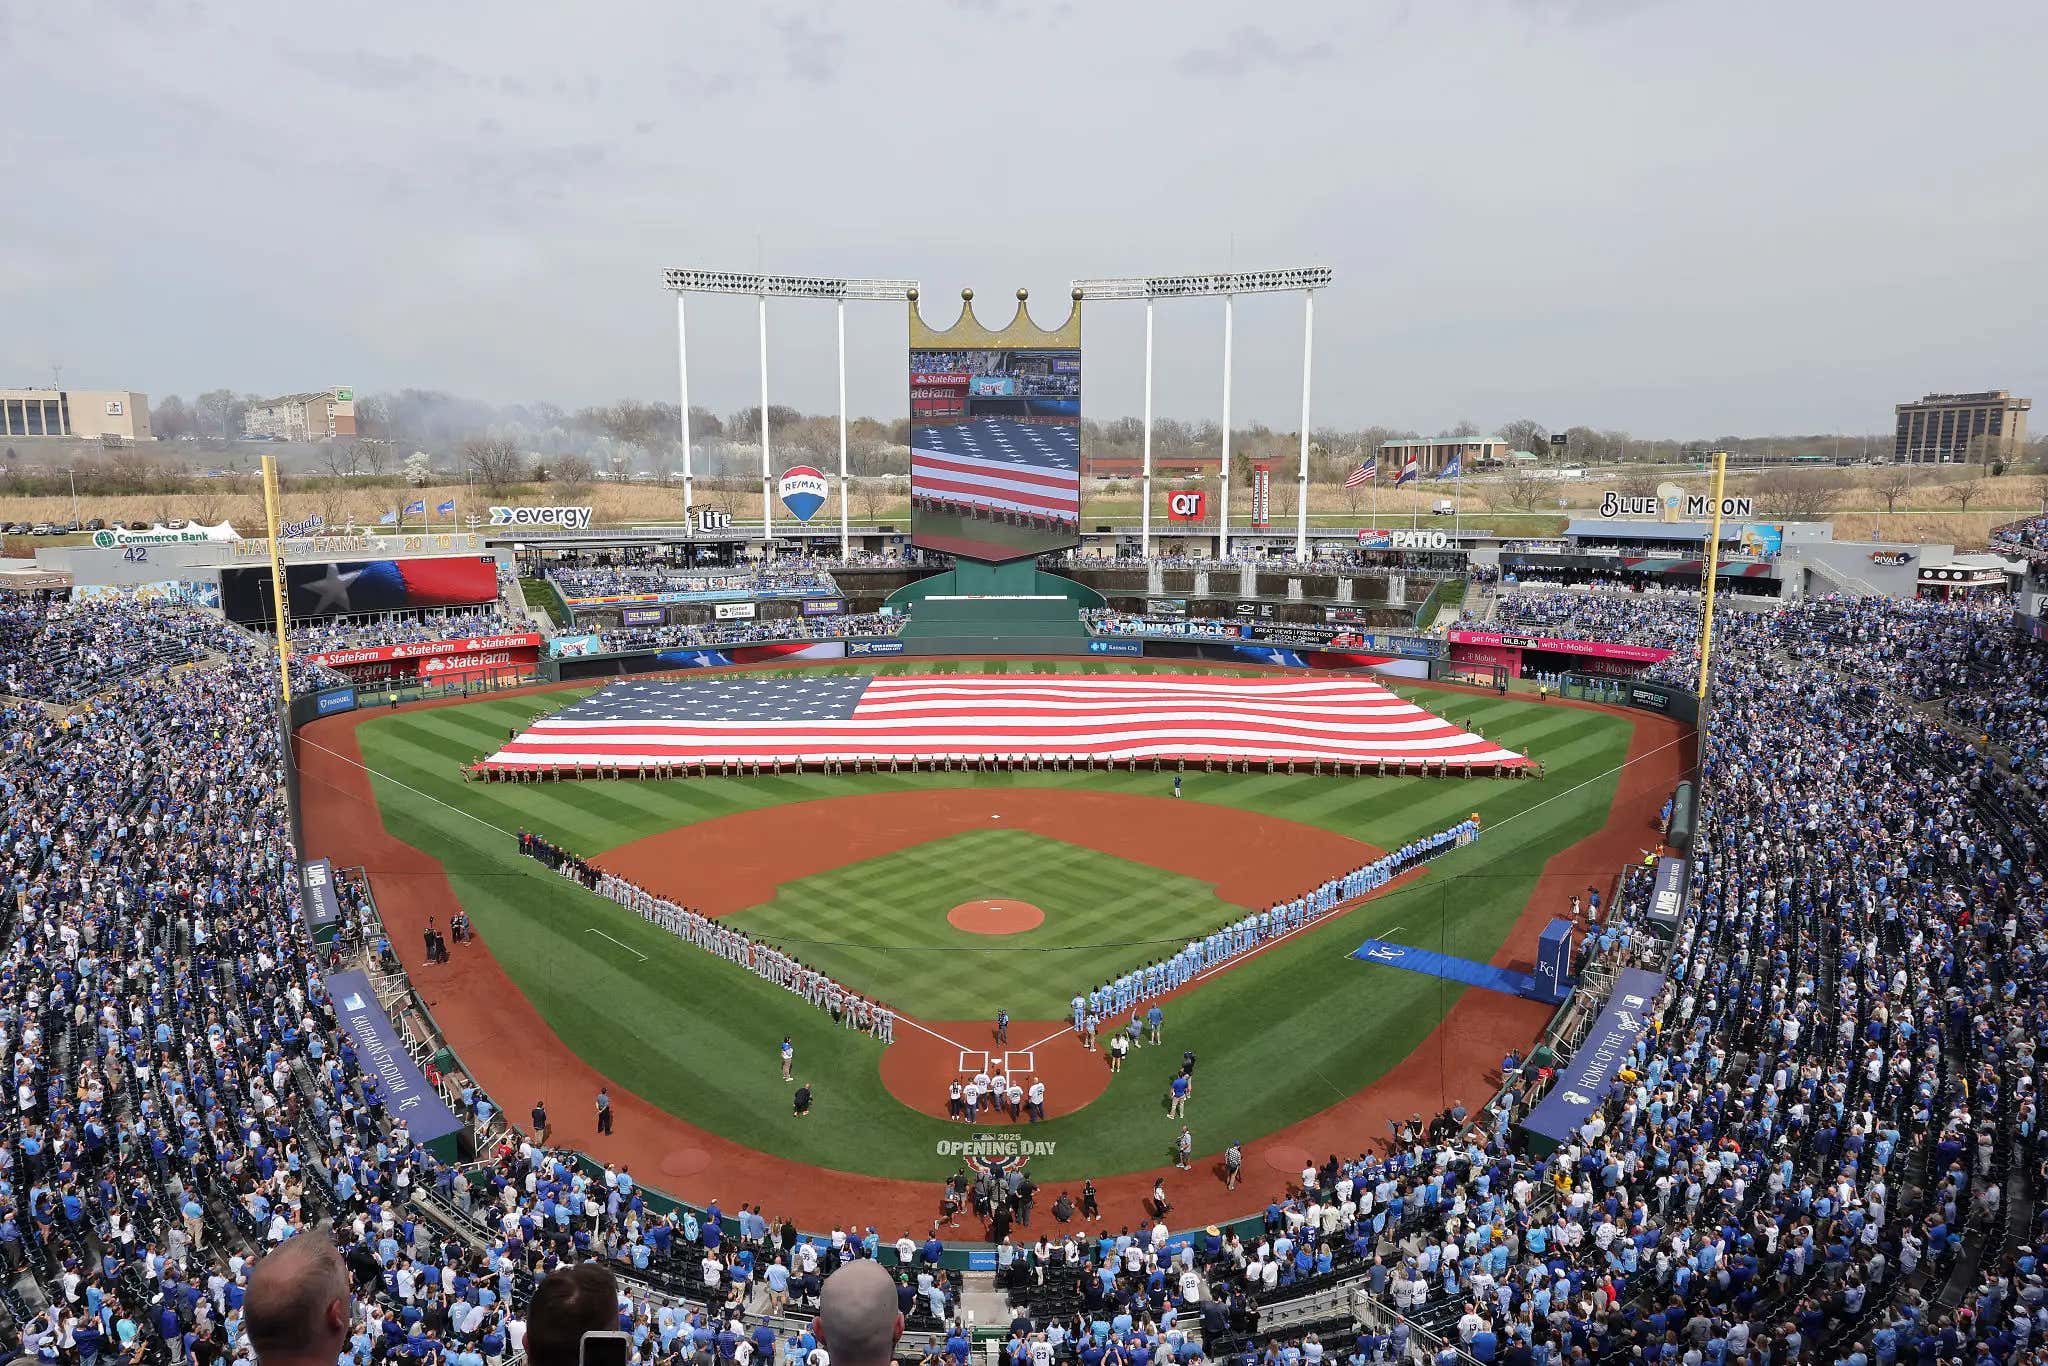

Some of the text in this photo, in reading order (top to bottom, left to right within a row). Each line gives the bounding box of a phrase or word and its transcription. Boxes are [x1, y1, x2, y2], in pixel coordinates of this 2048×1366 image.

[785, 480, 822, 492] RE/MAX
[1171, 494, 1200, 516] QT
[1601, 491, 1752, 518] BLUE MOON
[515, 507, 592, 528] evergy
[696, 510, 732, 533] Lite
[280, 514, 324, 539] Royals
[117, 530, 209, 544] Commerce Bank
[435, 536, 450, 548] 10
[467, 534, 477, 547] 5
[1360, 531, 1379, 540] PRICE
[1360, 536, 1389, 547] CHOPPER
[1392, 531, 1448, 549] PATIO
[313, 536, 370, 552] FAME
[404, 537, 422, 550] 20
[124, 547, 147, 562] 42
[1874, 556, 1905, 566] RIVALS
[1121, 622, 1185, 634] FOUNTAIN
[1190, 625, 1222, 636] DECK
[563, 643, 586, 653] SONIC
[1559, 642, 1593, 653] T-Mobile
[307, 864, 327, 887] UMB
[1654, 890, 1677, 915] UMB
[1539, 961, 1555, 978] KC
[1601, 1031, 1626, 1049] THE
[350, 1014, 384, 1057] KAUFFMAN
[373, 1053, 409, 1094] STADIUM
[1595, 1047, 1615, 1062] OF
[1578, 1060, 1608, 1090] HOME
[997, 1133, 1022, 1141] 2025
[936, 1140, 1057, 1156] OPENING DAY
[1036, 1351, 1047, 1360] 23
